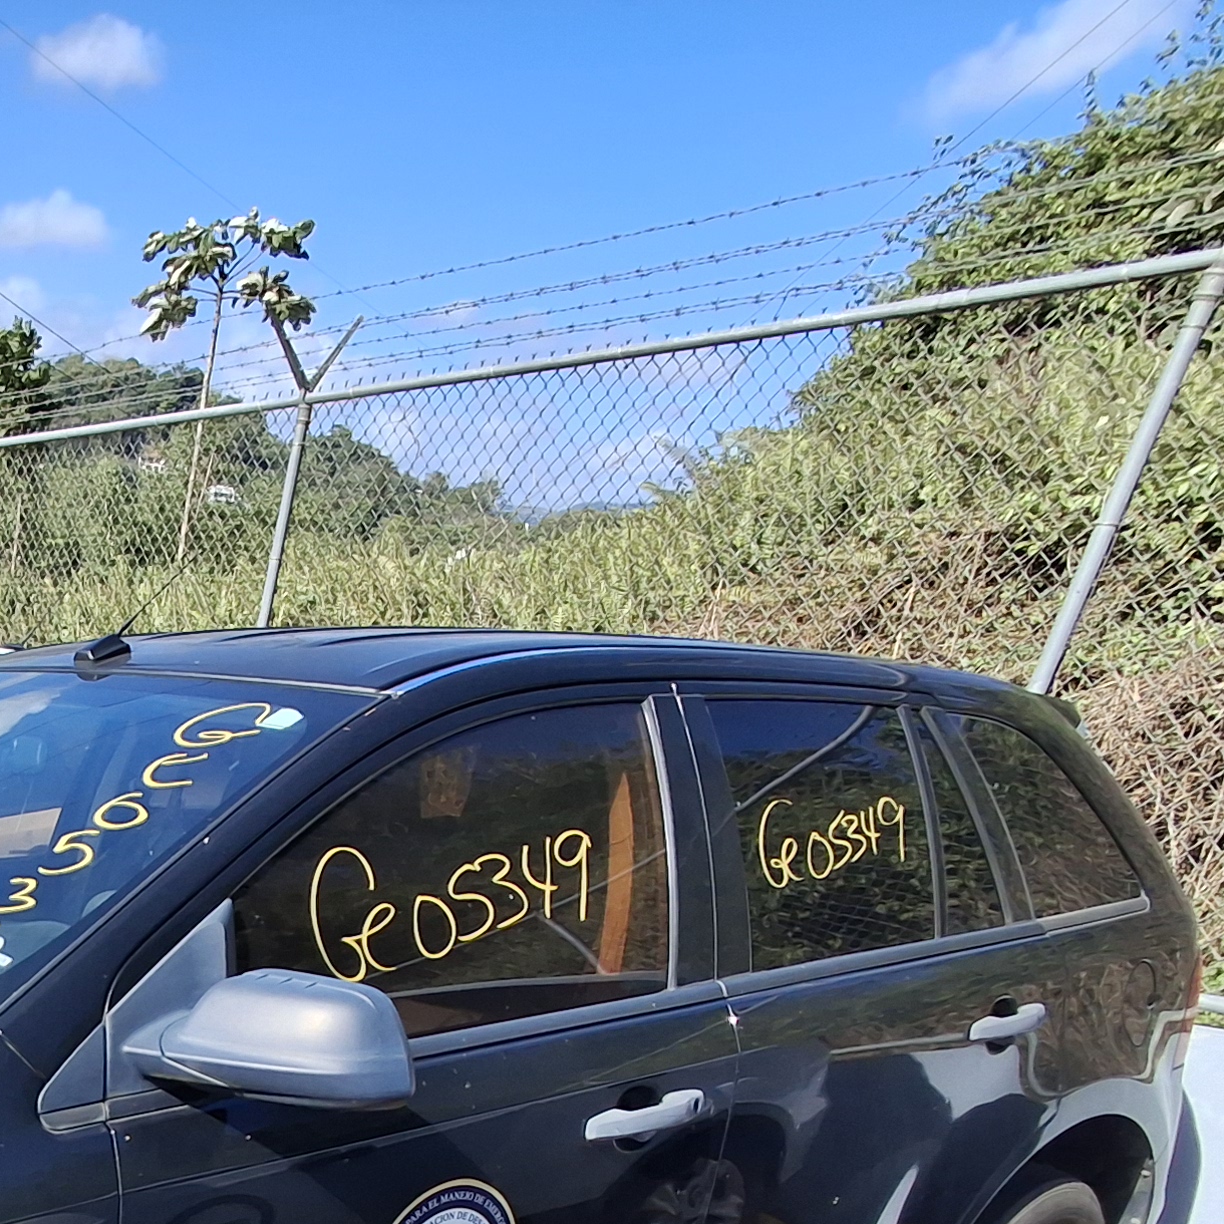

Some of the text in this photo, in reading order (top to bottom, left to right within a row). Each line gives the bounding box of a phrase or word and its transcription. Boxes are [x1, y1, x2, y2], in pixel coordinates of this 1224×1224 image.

[428, 1197, 440, 1210] EL
[440, 1191, 475, 1204] MANEJO
[474, 1193, 485, 1205] DE
[456, 1211, 469, 1220] DE
